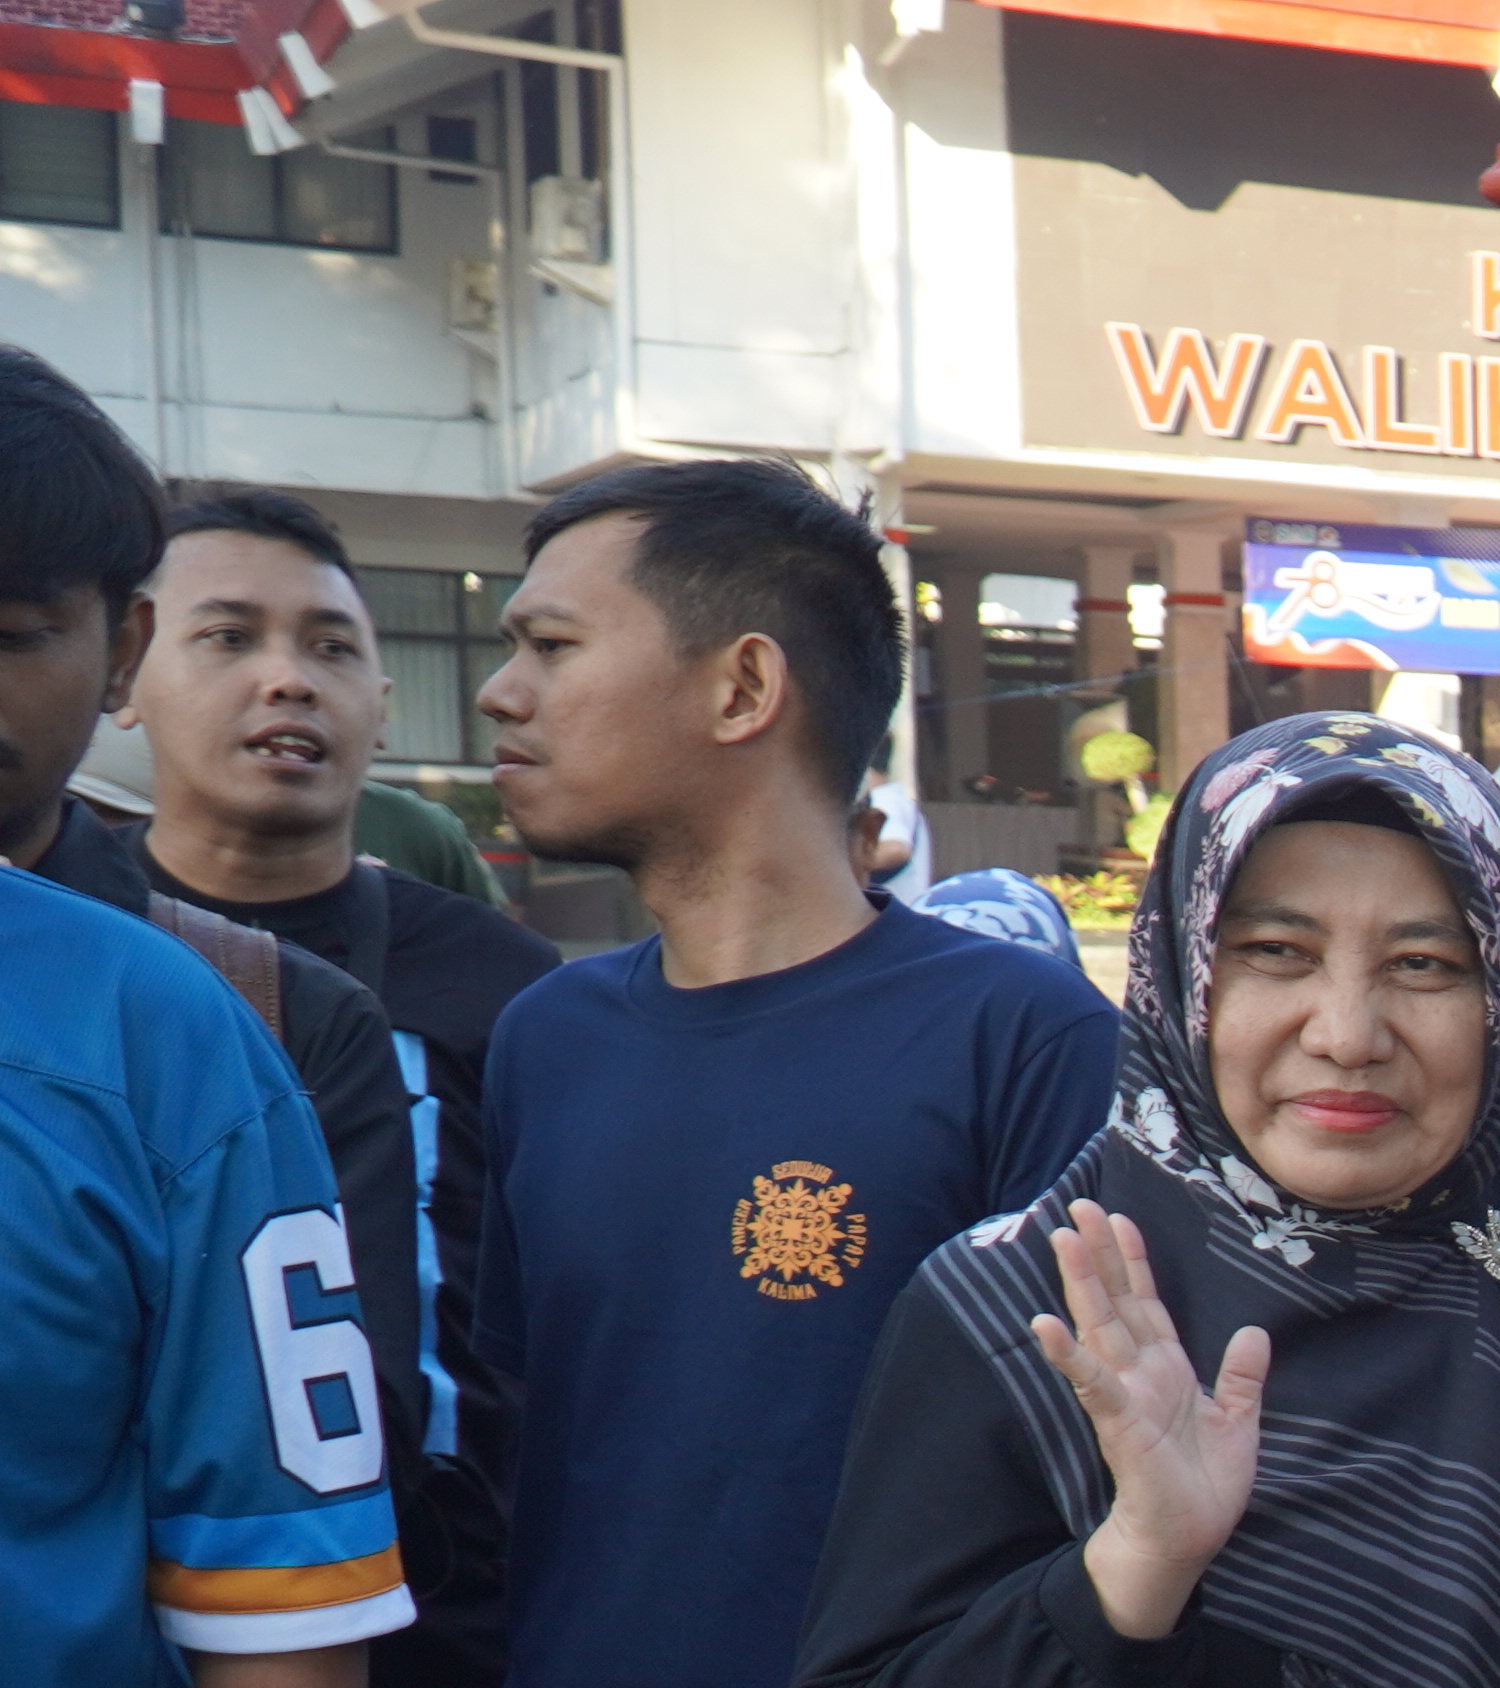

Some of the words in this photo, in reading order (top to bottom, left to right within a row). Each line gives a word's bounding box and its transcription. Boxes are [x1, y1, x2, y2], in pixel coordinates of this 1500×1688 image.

[842, 1213, 868, 1268] PAPAT
[757, 1277, 818, 1300] KALIMA
[238, 1201, 386, 1497] 6
